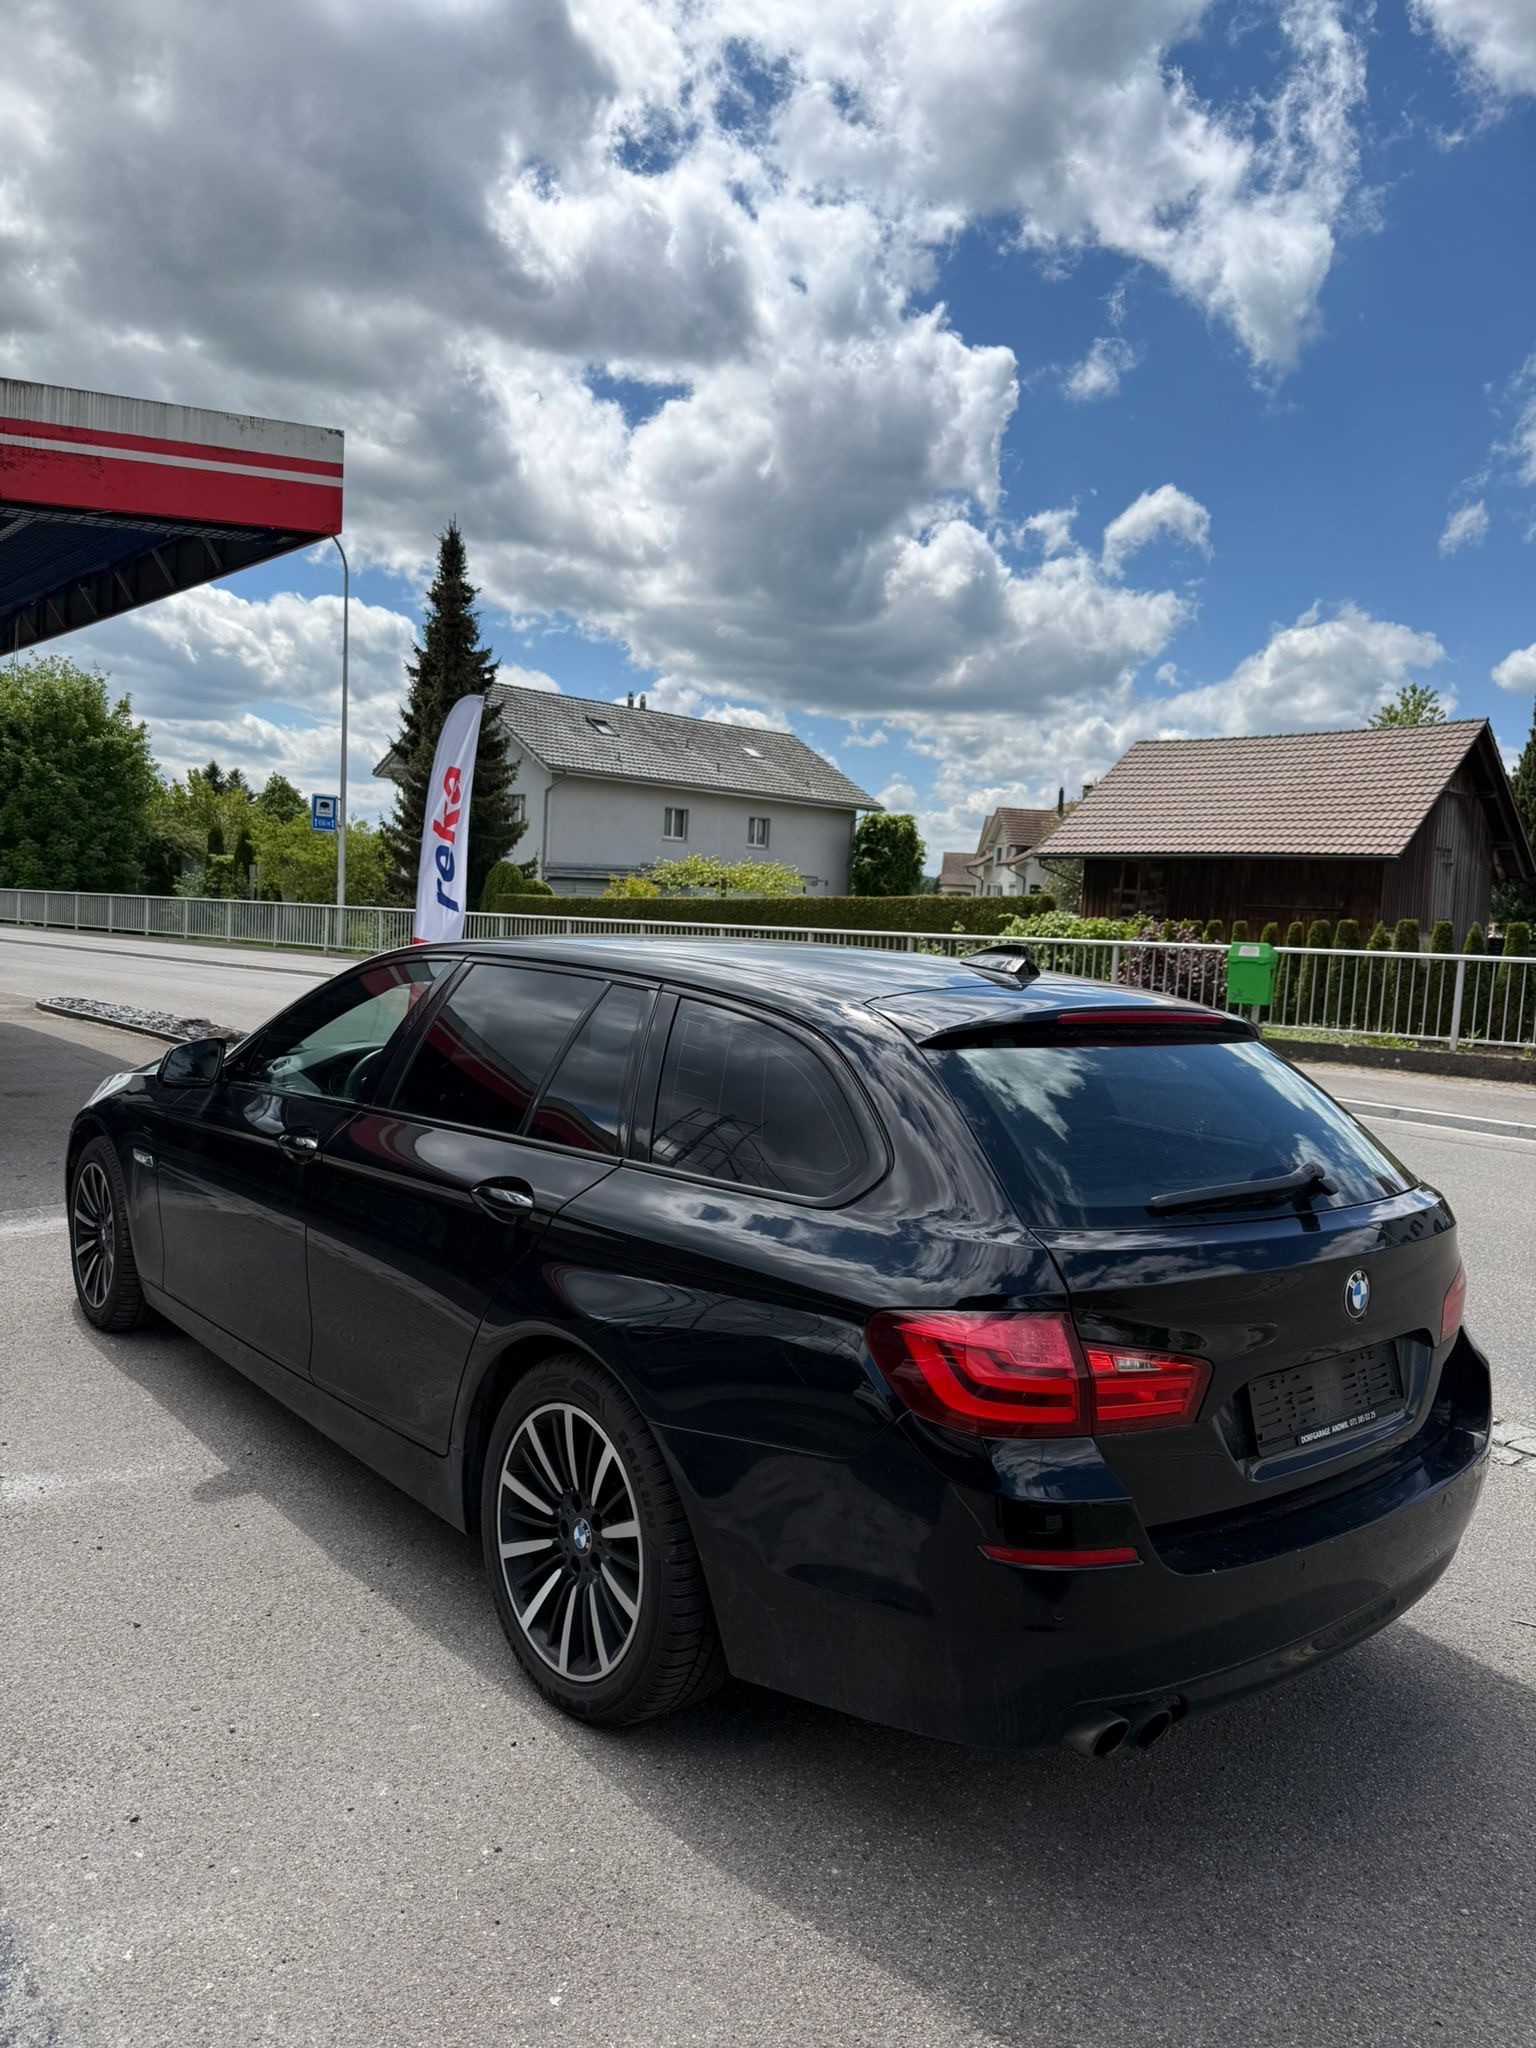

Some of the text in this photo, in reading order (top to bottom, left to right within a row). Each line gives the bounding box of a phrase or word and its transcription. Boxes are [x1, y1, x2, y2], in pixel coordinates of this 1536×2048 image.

[433, 766, 462, 913] reka
[1300, 1426, 1331, 1444] DORFGARAGE
[1331, 1420, 1350, 1433] ANDWIL
